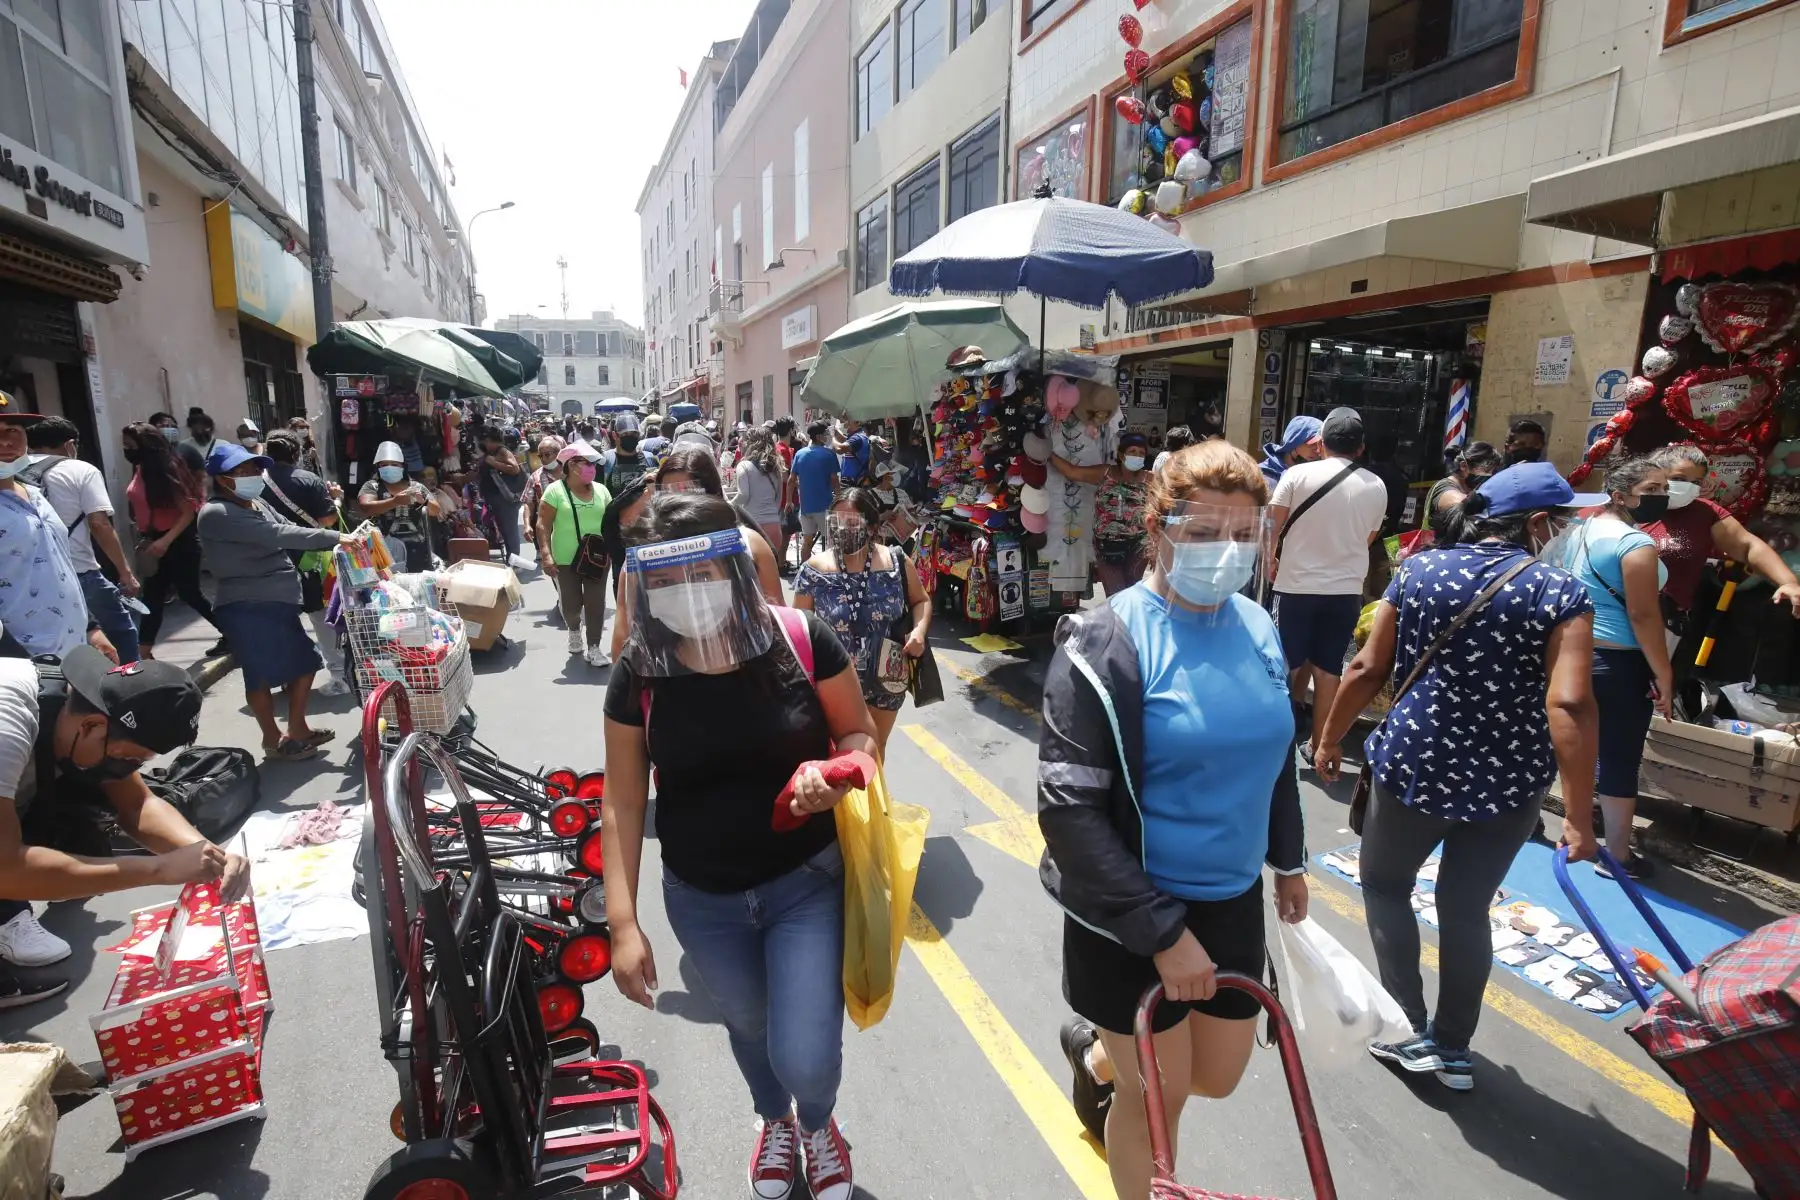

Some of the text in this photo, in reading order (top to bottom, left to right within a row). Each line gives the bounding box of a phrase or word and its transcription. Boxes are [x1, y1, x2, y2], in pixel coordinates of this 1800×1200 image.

[642, 548, 665, 559] Face
[670, 541, 706, 554] Shield
[124, 1023, 138, 1034] K
[183, 1078, 197, 1089] R
[149, 1116, 163, 1128] K
